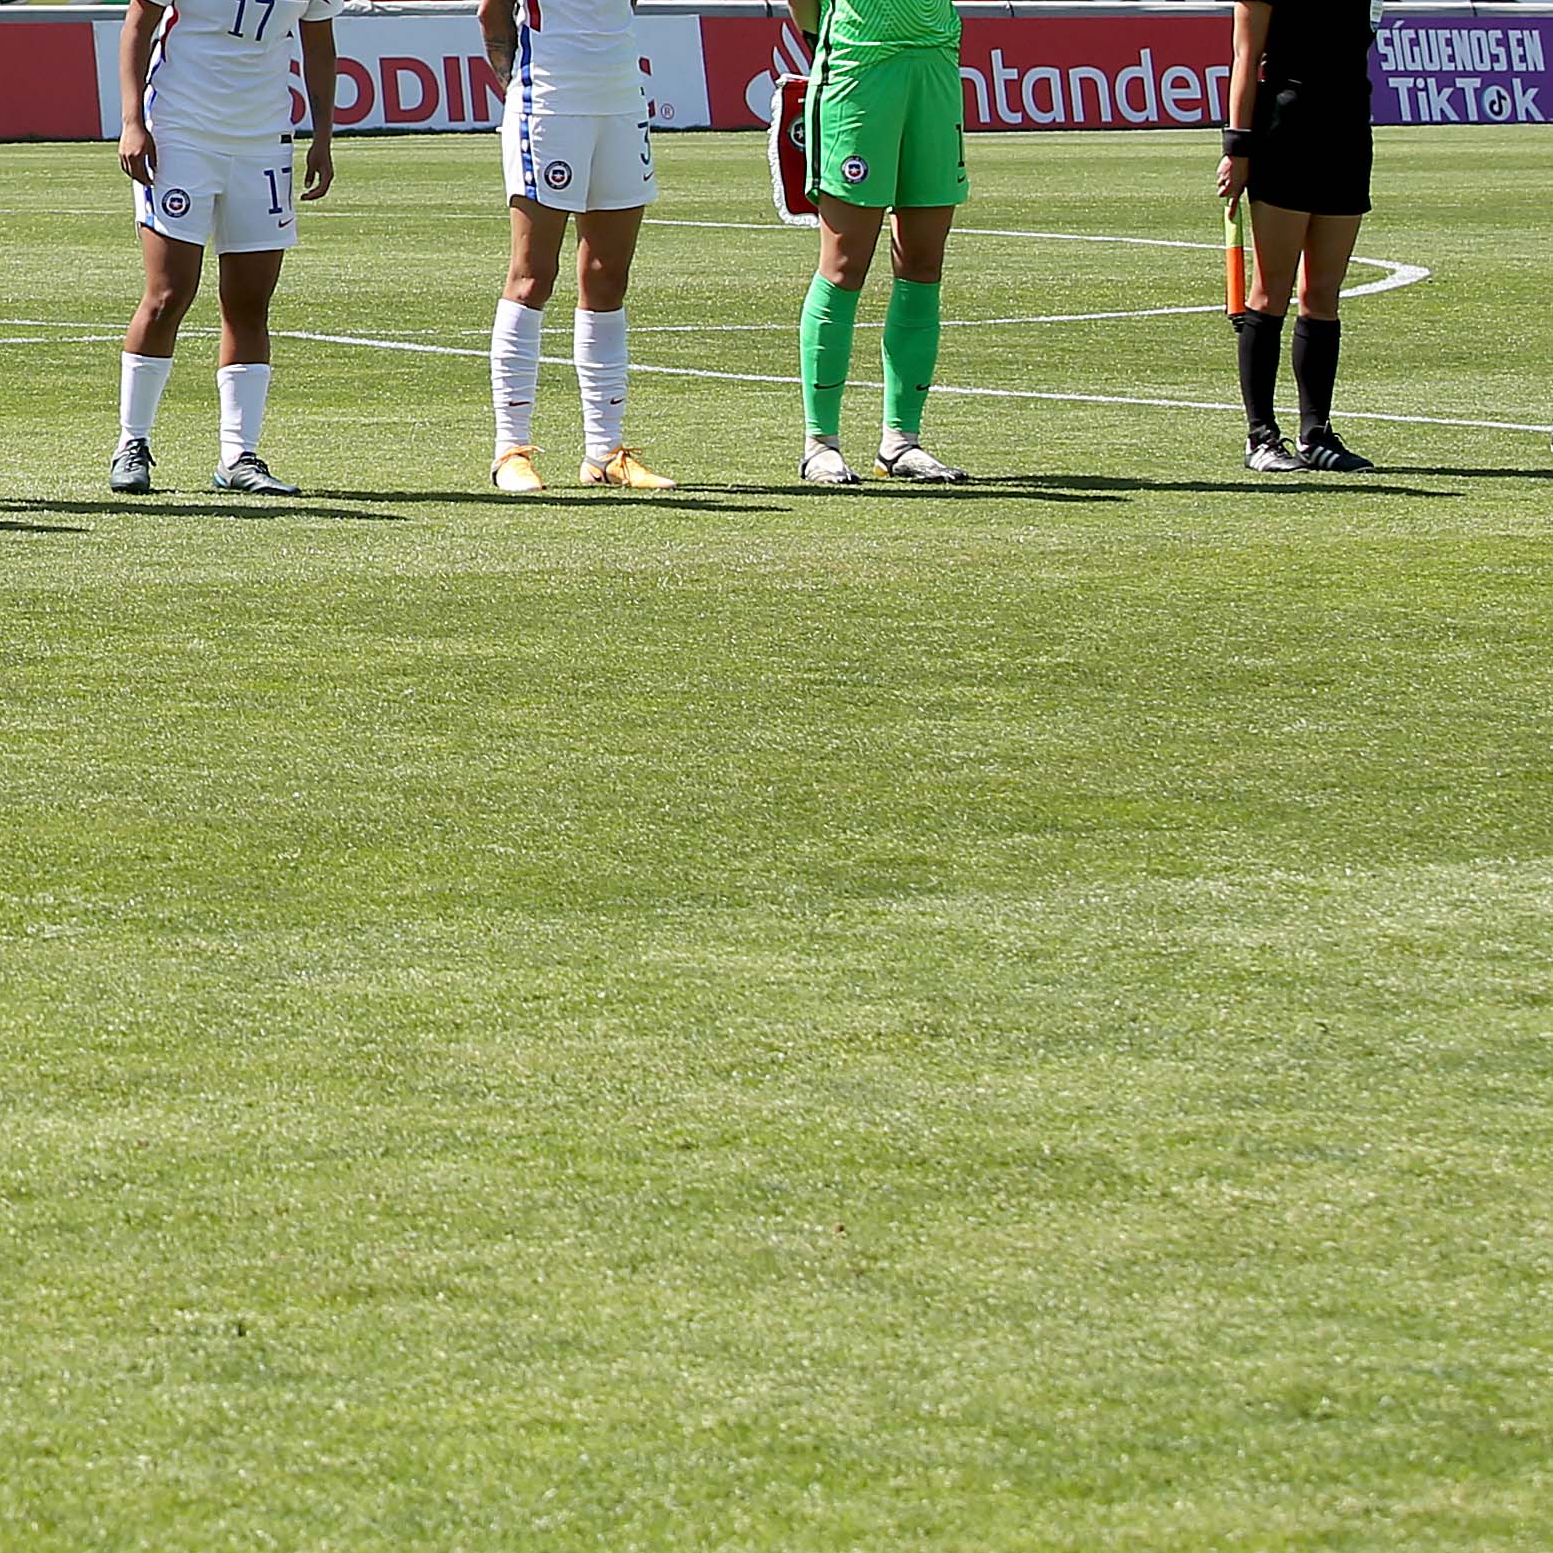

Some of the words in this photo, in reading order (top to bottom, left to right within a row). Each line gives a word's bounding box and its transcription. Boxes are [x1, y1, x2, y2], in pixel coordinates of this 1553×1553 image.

[1376, 20, 1507, 72] SÍGUENOS
[1508, 29, 1546, 72] EN
[1388, 76, 1540, 122] TikTok
